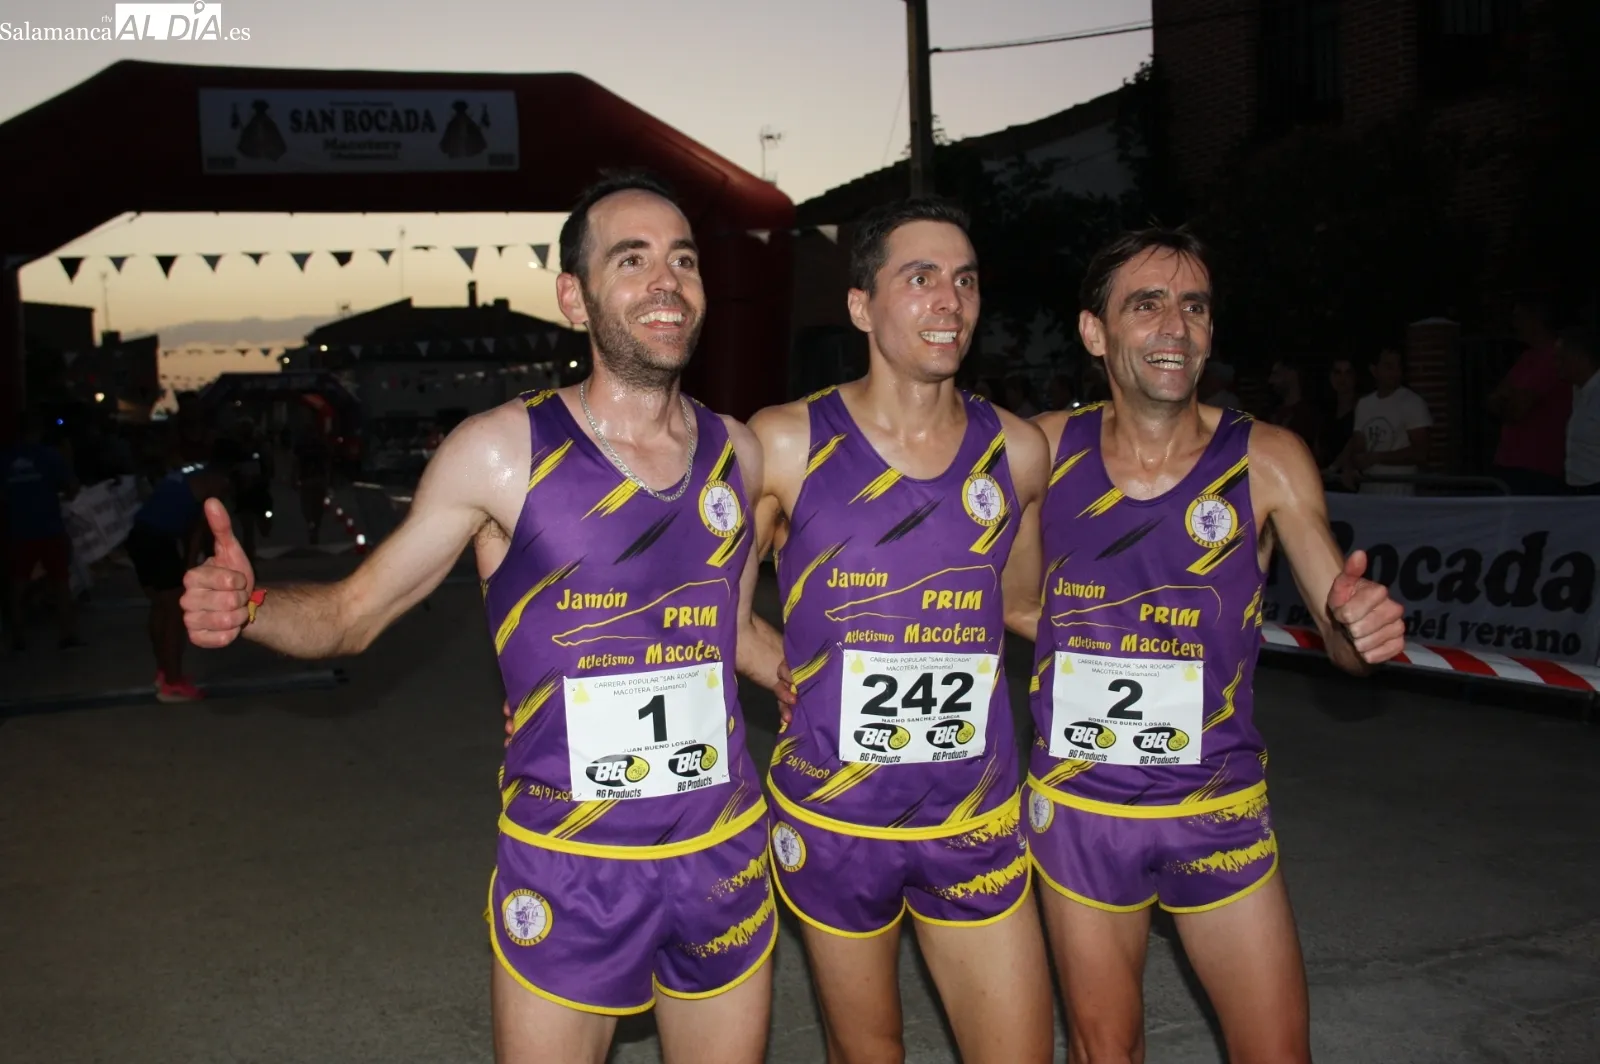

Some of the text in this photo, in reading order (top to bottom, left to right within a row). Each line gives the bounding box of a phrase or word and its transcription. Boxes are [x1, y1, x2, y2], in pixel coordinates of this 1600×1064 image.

[290, 108, 437, 133] SAN ROCADA
[826, 567, 888, 588] Jamón
[1053, 577, 1106, 599] Jamón
[556, 588, 628, 610] Jamón
[921, 590, 983, 610] PRIM
[663, 605, 718, 628] PRIM
[1139, 603, 1200, 628] PRIM
[844, 622, 986, 645] Atletismo Macotera
[1405, 610, 1581, 656] del verano
[1067, 633, 1204, 658] Atletismo Macotera
[577, 654, 635, 669] Atletismo
[1077, 658, 1102, 666] CARRERA
[1091, 668, 1123, 676] MACOTERA
[594, 680, 627, 689] CARRERA
[628, 677, 659, 686] POPULAR
[613, 686, 650, 696] MACOTERA
[860, 671, 974, 717] 242
[1106, 678, 1144, 720] 2
[638, 694, 667, 742] 1
[861, 728, 892, 746] BG
[933, 725, 959, 744] BG
[1070, 726, 1098, 744] BG
[1140, 732, 1169, 749] BG
[644, 743, 670, 751] BUENO
[932, 750, 968, 761] BG Products
[1068, 749, 1108, 762] BG Products
[676, 750, 702, 773] BG
[786, 755, 830, 779] 26/9/2009
[859, 752, 901, 763] BG Products
[1139, 755, 1180, 764] BG Products
[595, 760, 627, 782] BG
[607, 788, 641, 799] Products
[677, 776, 712, 792] BG Products
